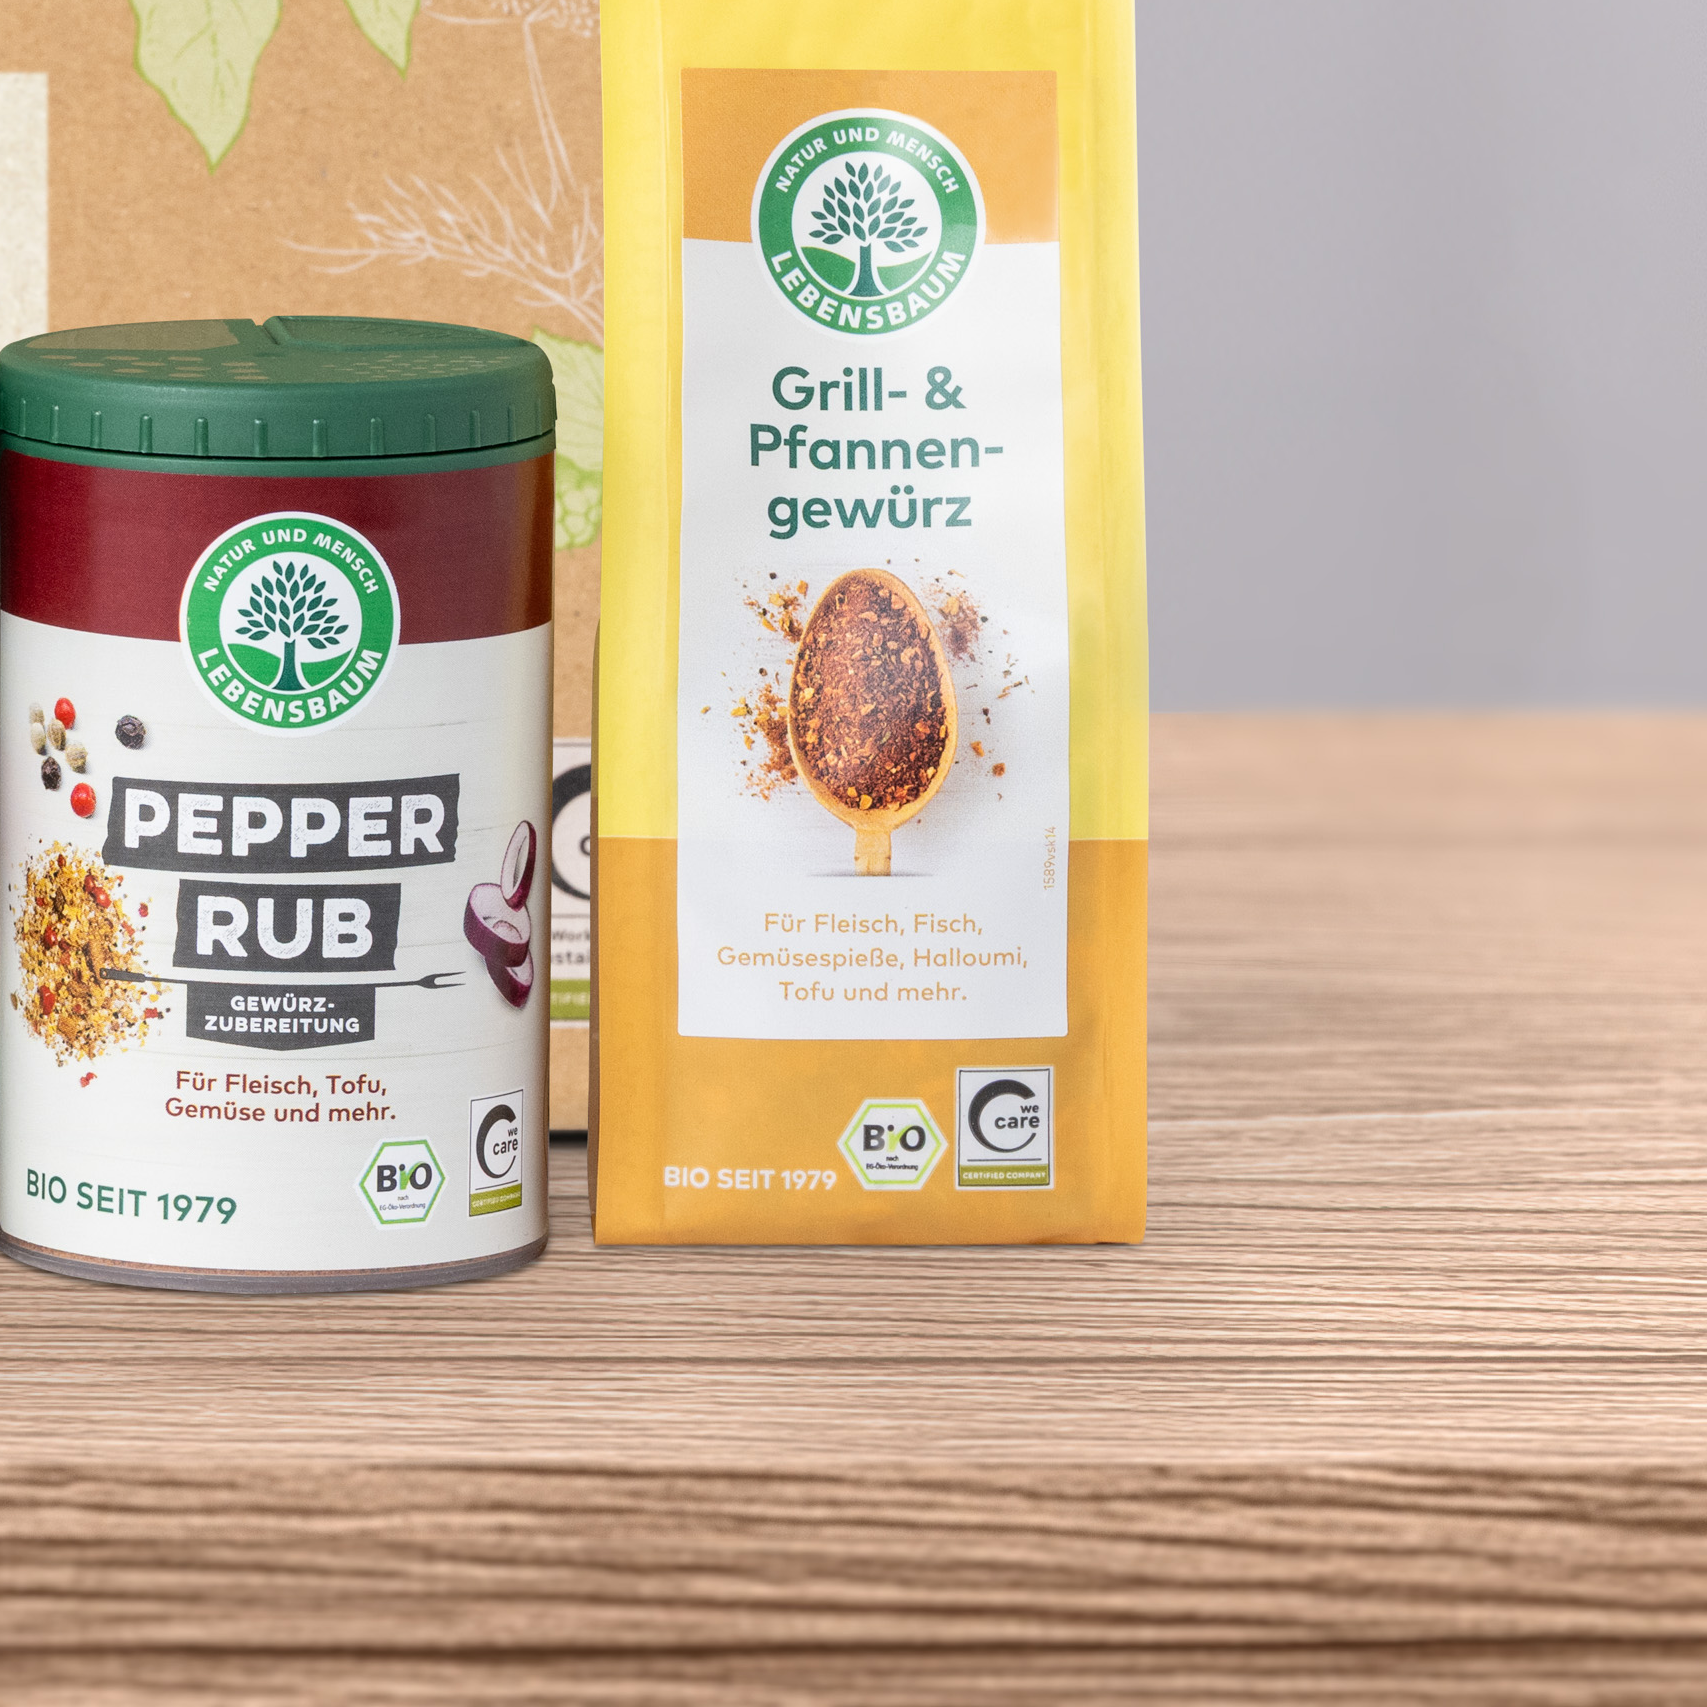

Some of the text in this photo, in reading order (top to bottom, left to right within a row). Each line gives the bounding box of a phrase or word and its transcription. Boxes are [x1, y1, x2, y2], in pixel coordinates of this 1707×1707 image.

[775, 127, 959, 193] NATUR UND MENSCH
[771, 250, 966, 329] LEBENSBAUM
[772, 365, 967, 411] Grill- &
[750, 423, 1003, 469] Pfannen-
[768, 485, 972, 539] gewürz
[203, 528, 379, 594] NATUR UND MENSCH
[198, 648, 382, 723] LEBENSBAUM
[124, 787, 445, 858] PEPPER
[1043, 826, 1056, 890] 1589vsk14
[196, 894, 373, 959] RUB
[764, 913, 982, 935] Für Fleisch, Fisch,
[717, 946, 1027, 971] Gemüsespieße, Halloumi,
[230, 993, 335, 1012] GEWÜRZ-
[779, 981, 967, 1001] Tofu und mehr.
[204, 1015, 360, 1033] ZUBEREITUNG
[176, 1071, 387, 1098] Für Fleisch, Tofu,
[165, 1097, 396, 1122] Gemüse und mehr.
[1020, 1105, 1039, 1113] we
[507, 1126, 518, 1136] we
[994, 1115, 1040, 1129] care
[493, 1138, 519, 1155] care
[664, 1166, 837, 1190] BIO SEIT 1979
[963, 1171, 1046, 1180] CERTIFIED COMPANY
[26, 1168, 238, 1225] BIO SEIT 1979
[379, 1202, 426, 1211] EG-Öko-Verordnung
